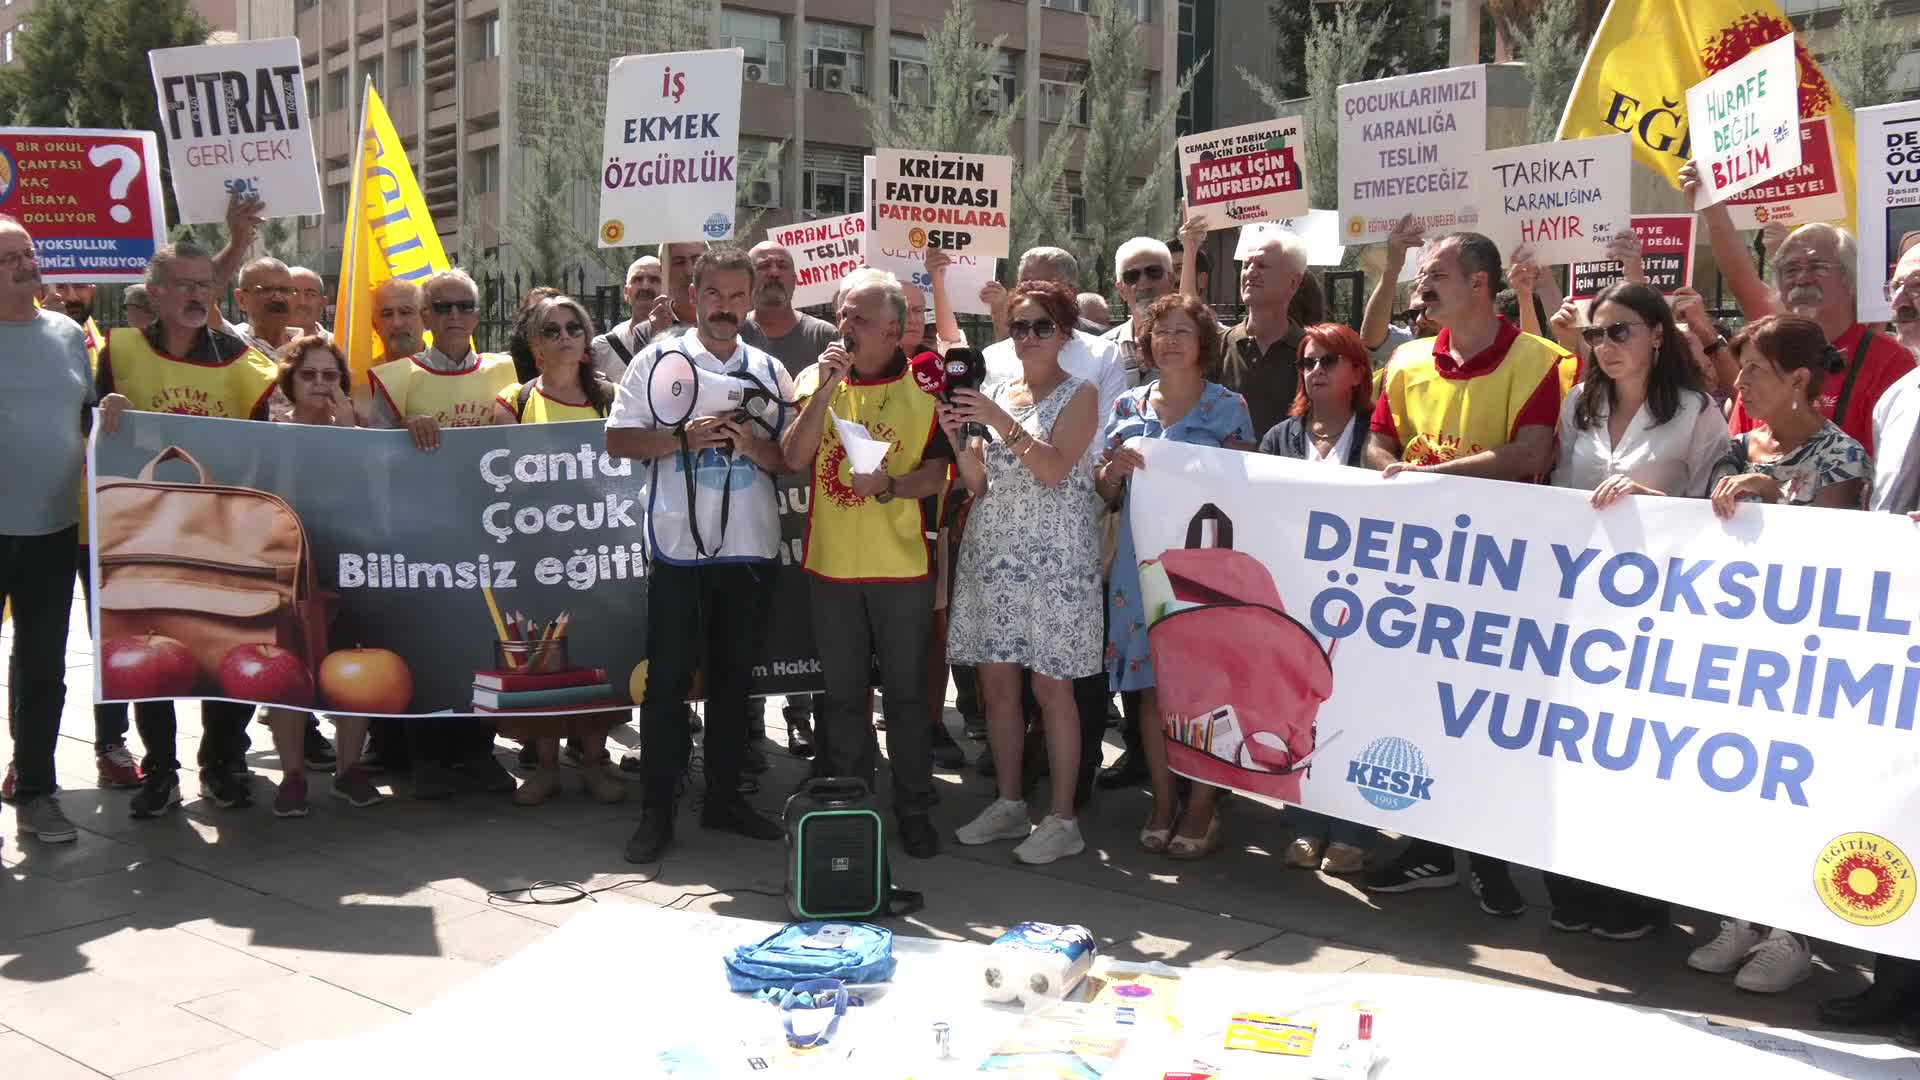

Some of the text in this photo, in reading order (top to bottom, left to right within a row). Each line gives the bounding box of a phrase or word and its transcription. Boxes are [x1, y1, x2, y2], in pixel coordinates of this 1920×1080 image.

[662, 66, 686, 104] İŞ
[1707, 69, 1767, 123] HURAFE
[162, 65, 300, 140] FITRAT
[1345, 81, 1477, 120] ÇOCUKLARIMIZI
[623, 113, 720, 143] EKMEK
[1363, 108, 1457, 142] KARANLIĞA
[16, 142, 39, 152] BİR
[45, 142, 85, 153] OKUL
[187, 138, 292, 168] GERİ ÇEK!
[1185, 140, 1219, 154] CEMAAT
[1221, 137, 1234, 147] VE
[1379, 142, 1438, 168] TESLİM
[18, 159, 82, 173] ÇANTASI
[604, 150, 735, 189] ÖZGÜRLÜK
[900, 154, 984, 182] KRİZİN
[1200, 153, 1285, 182] HALK İÇİN
[1492, 158, 1595, 188] TARİKAT
[1711, 141, 1771, 190] BİLİM
[19, 177, 49, 189] KAÇ
[224, 178, 258, 194] SOL
[886, 182, 998, 208] FATURASI
[1197, 171, 1291, 200] MÜFREDAT!
[1354, 168, 1469, 201] ETMEYECEĞİZ
[22, 193, 78, 205] LİRAYA
[1504, 187, 1601, 214] KARANLIĞINA
[23, 213, 97, 223] DOLUYOR
[879, 204, 1006, 228] PATRONLARA
[1521, 215, 1584, 242] HAYIR
[1647, 226, 1663, 234] VE
[35, 239, 117, 251] YOKSULLUK
[776, 217, 864, 246] KARANLIĞA
[927, 230, 971, 250] SEP
[1648, 236, 1684, 246] DEĞİL
[79, 256, 148, 268] VURUYOR
[1576, 277, 1593, 291] İÇİN
[480, 444, 632, 493] Çanta
[482, 494, 637, 544] Çocuk
[338, 542, 645, 591] Bilimsiz eğiti
[1304, 510, 1920, 635] DERİN YOKSULL
[1310, 569, 1920, 731] ÖĞRENCİLERİMİ
[1437, 681, 1815, 808] VURUYOR
[1346, 760, 1434, 801] KESK
